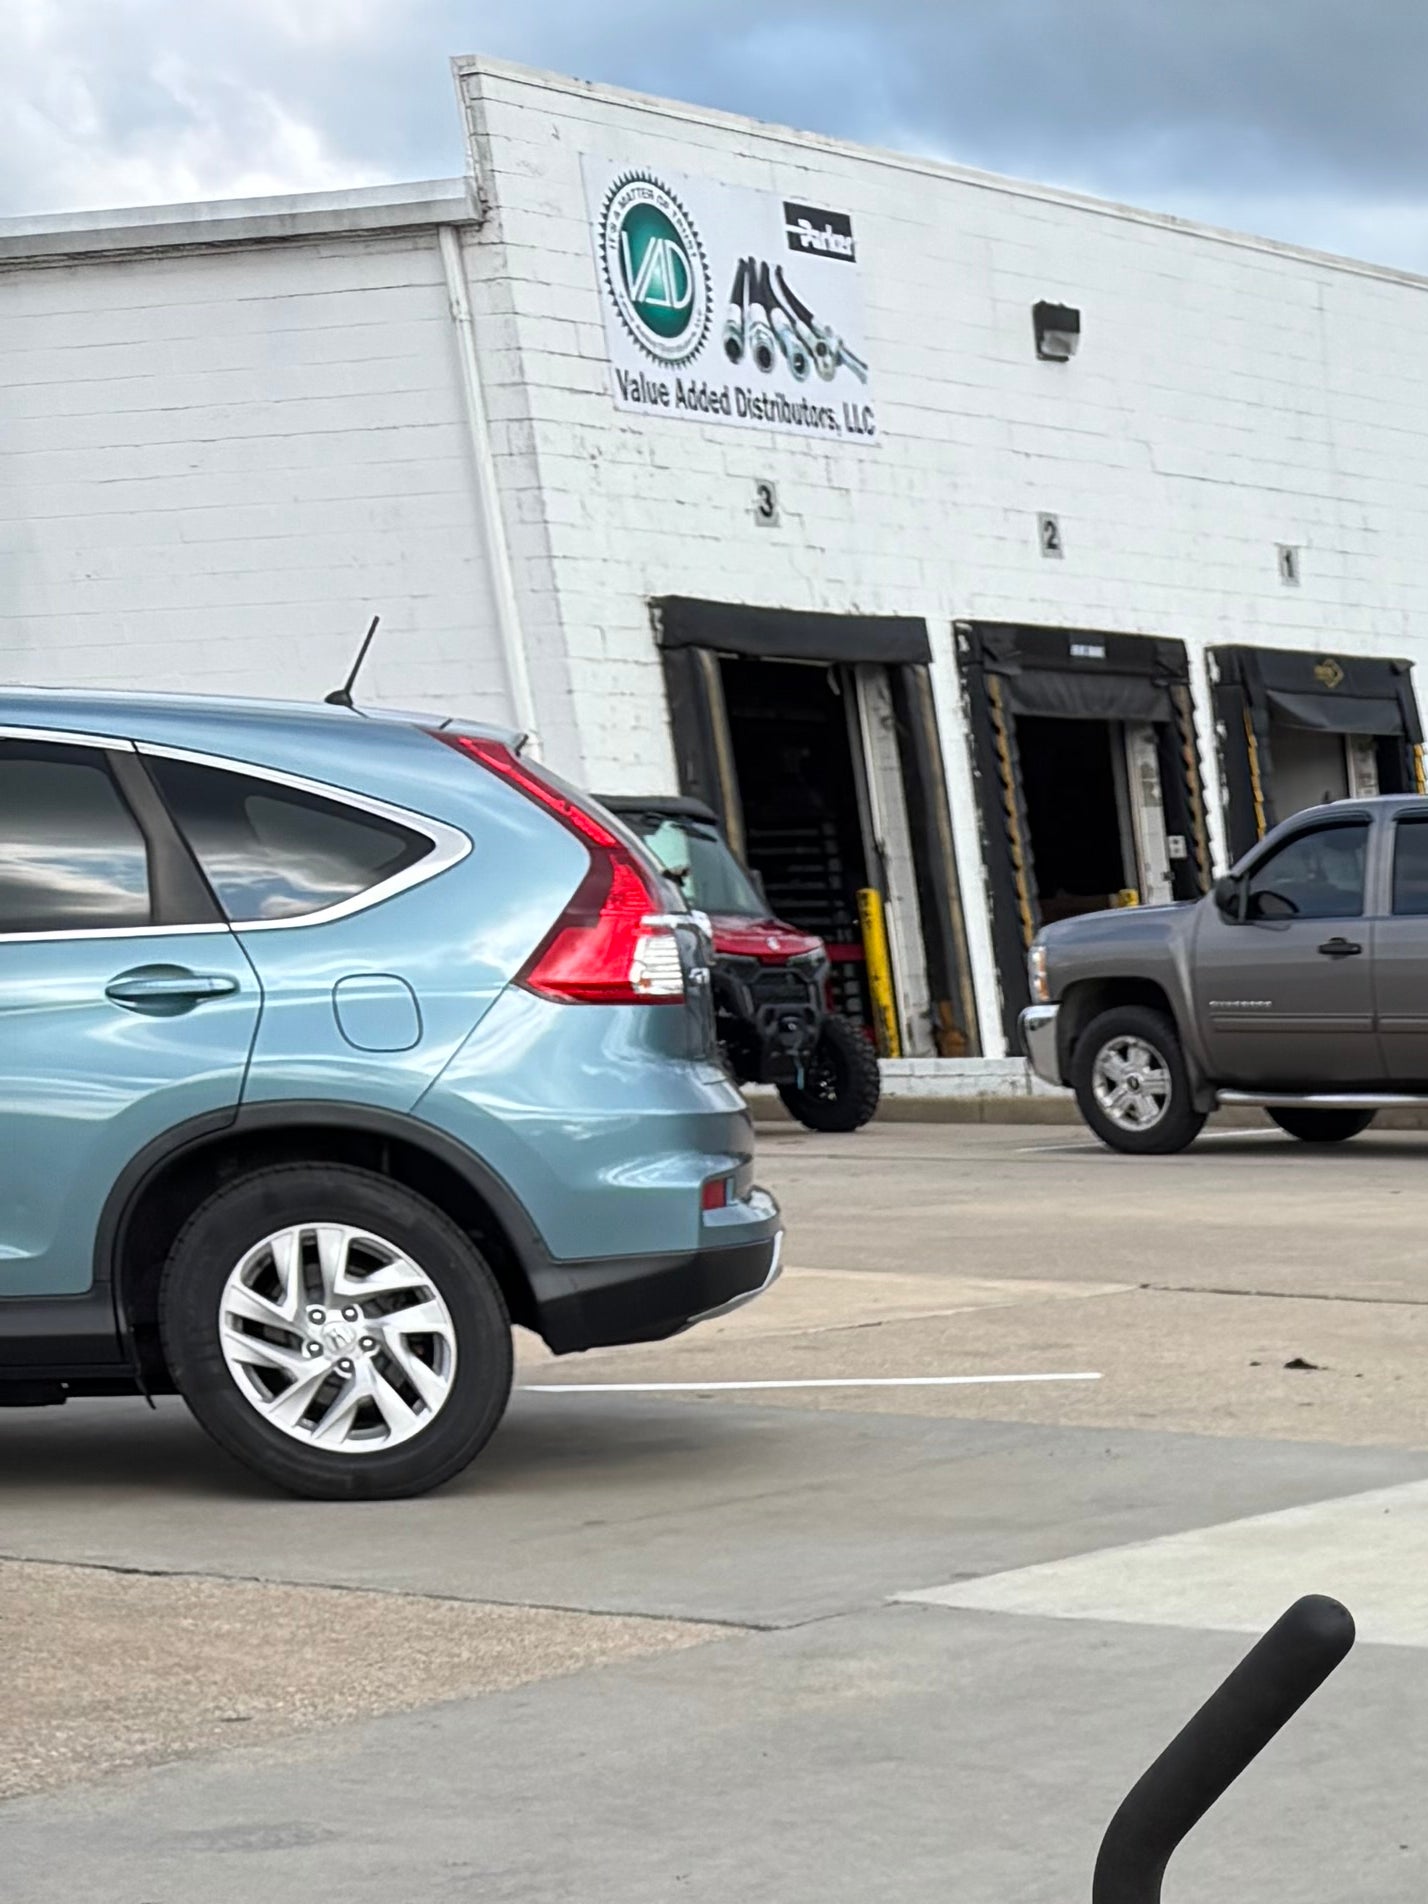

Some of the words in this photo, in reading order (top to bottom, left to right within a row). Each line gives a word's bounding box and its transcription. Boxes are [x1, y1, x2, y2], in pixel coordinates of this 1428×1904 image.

[614, 367, 670, 408] Value
[675, 377, 732, 416] Added
[735, 386, 842, 436] Distributors,
[842, 401, 876, 436] LLC
[757, 484, 774, 518] 3
[1043, 520, 1059, 550] 2
